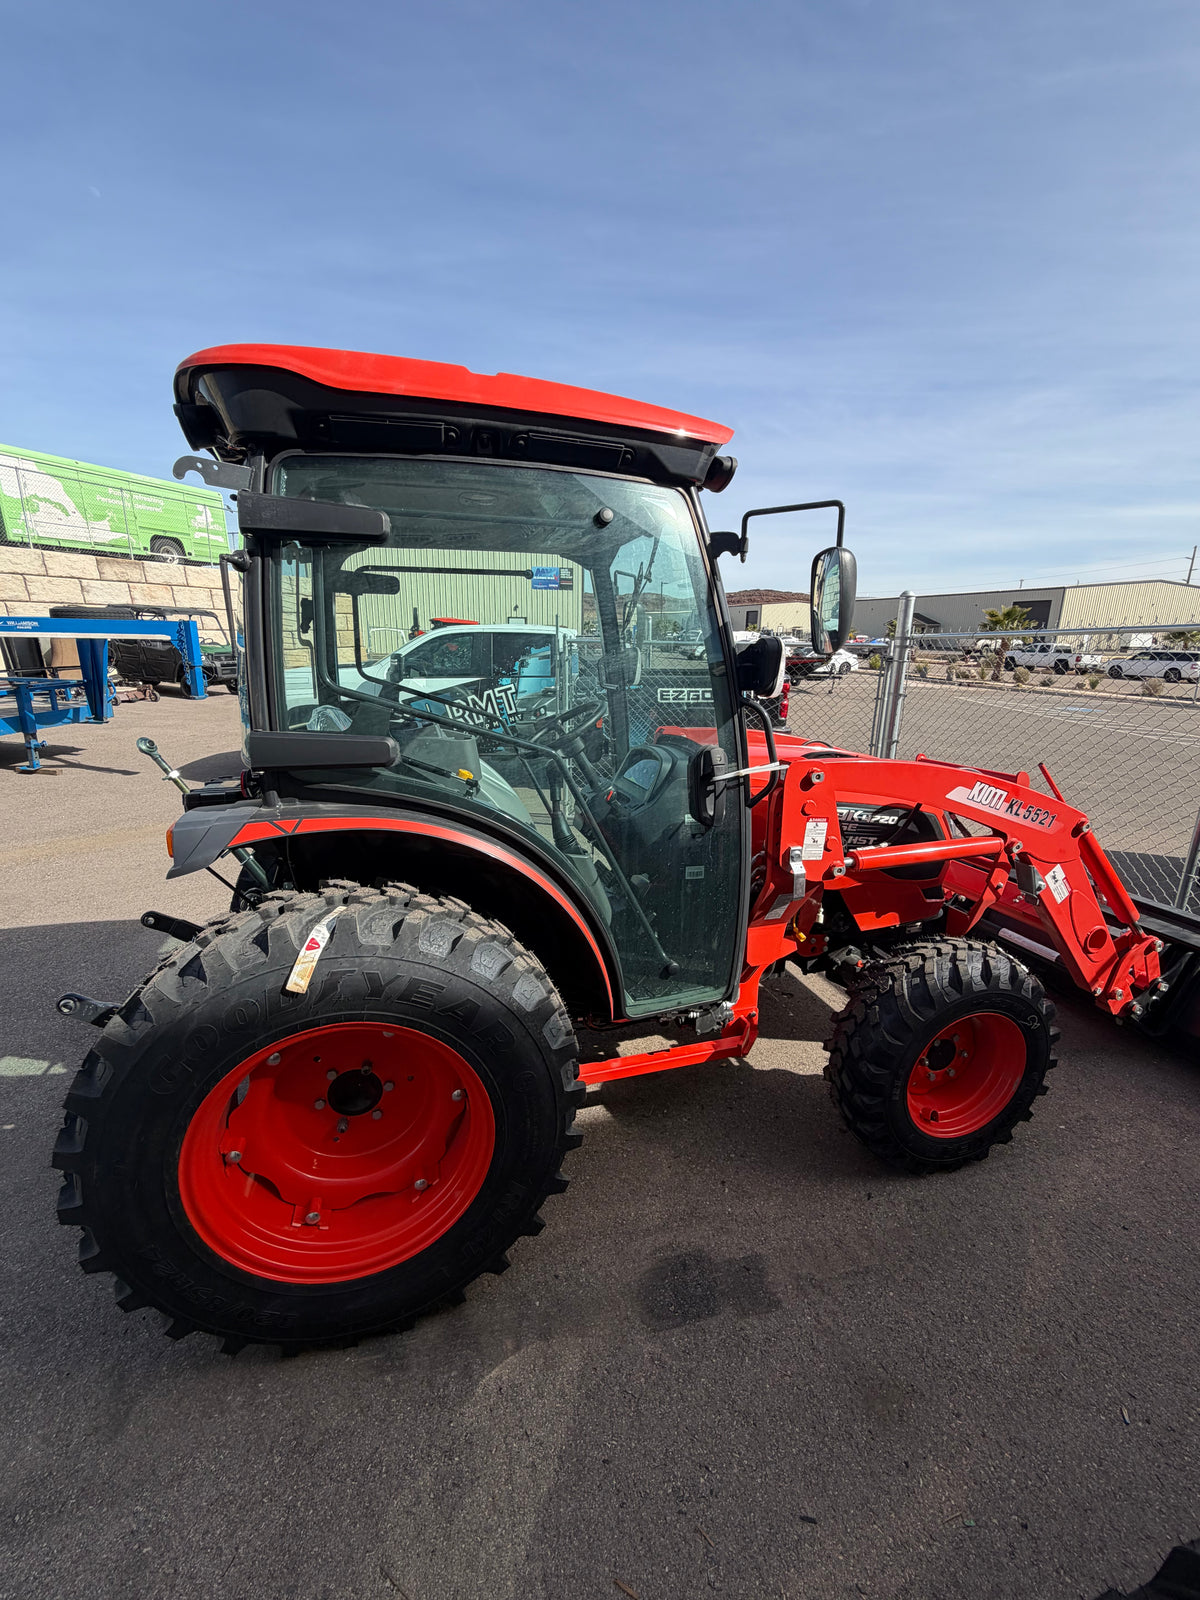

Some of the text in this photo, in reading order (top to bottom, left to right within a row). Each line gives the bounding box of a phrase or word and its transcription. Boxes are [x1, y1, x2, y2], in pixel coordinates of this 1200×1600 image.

[657, 687, 715, 703] EZGO
[967, 780, 1009, 811] KIOTI
[148, 967, 517, 1097] GOODYEAR
